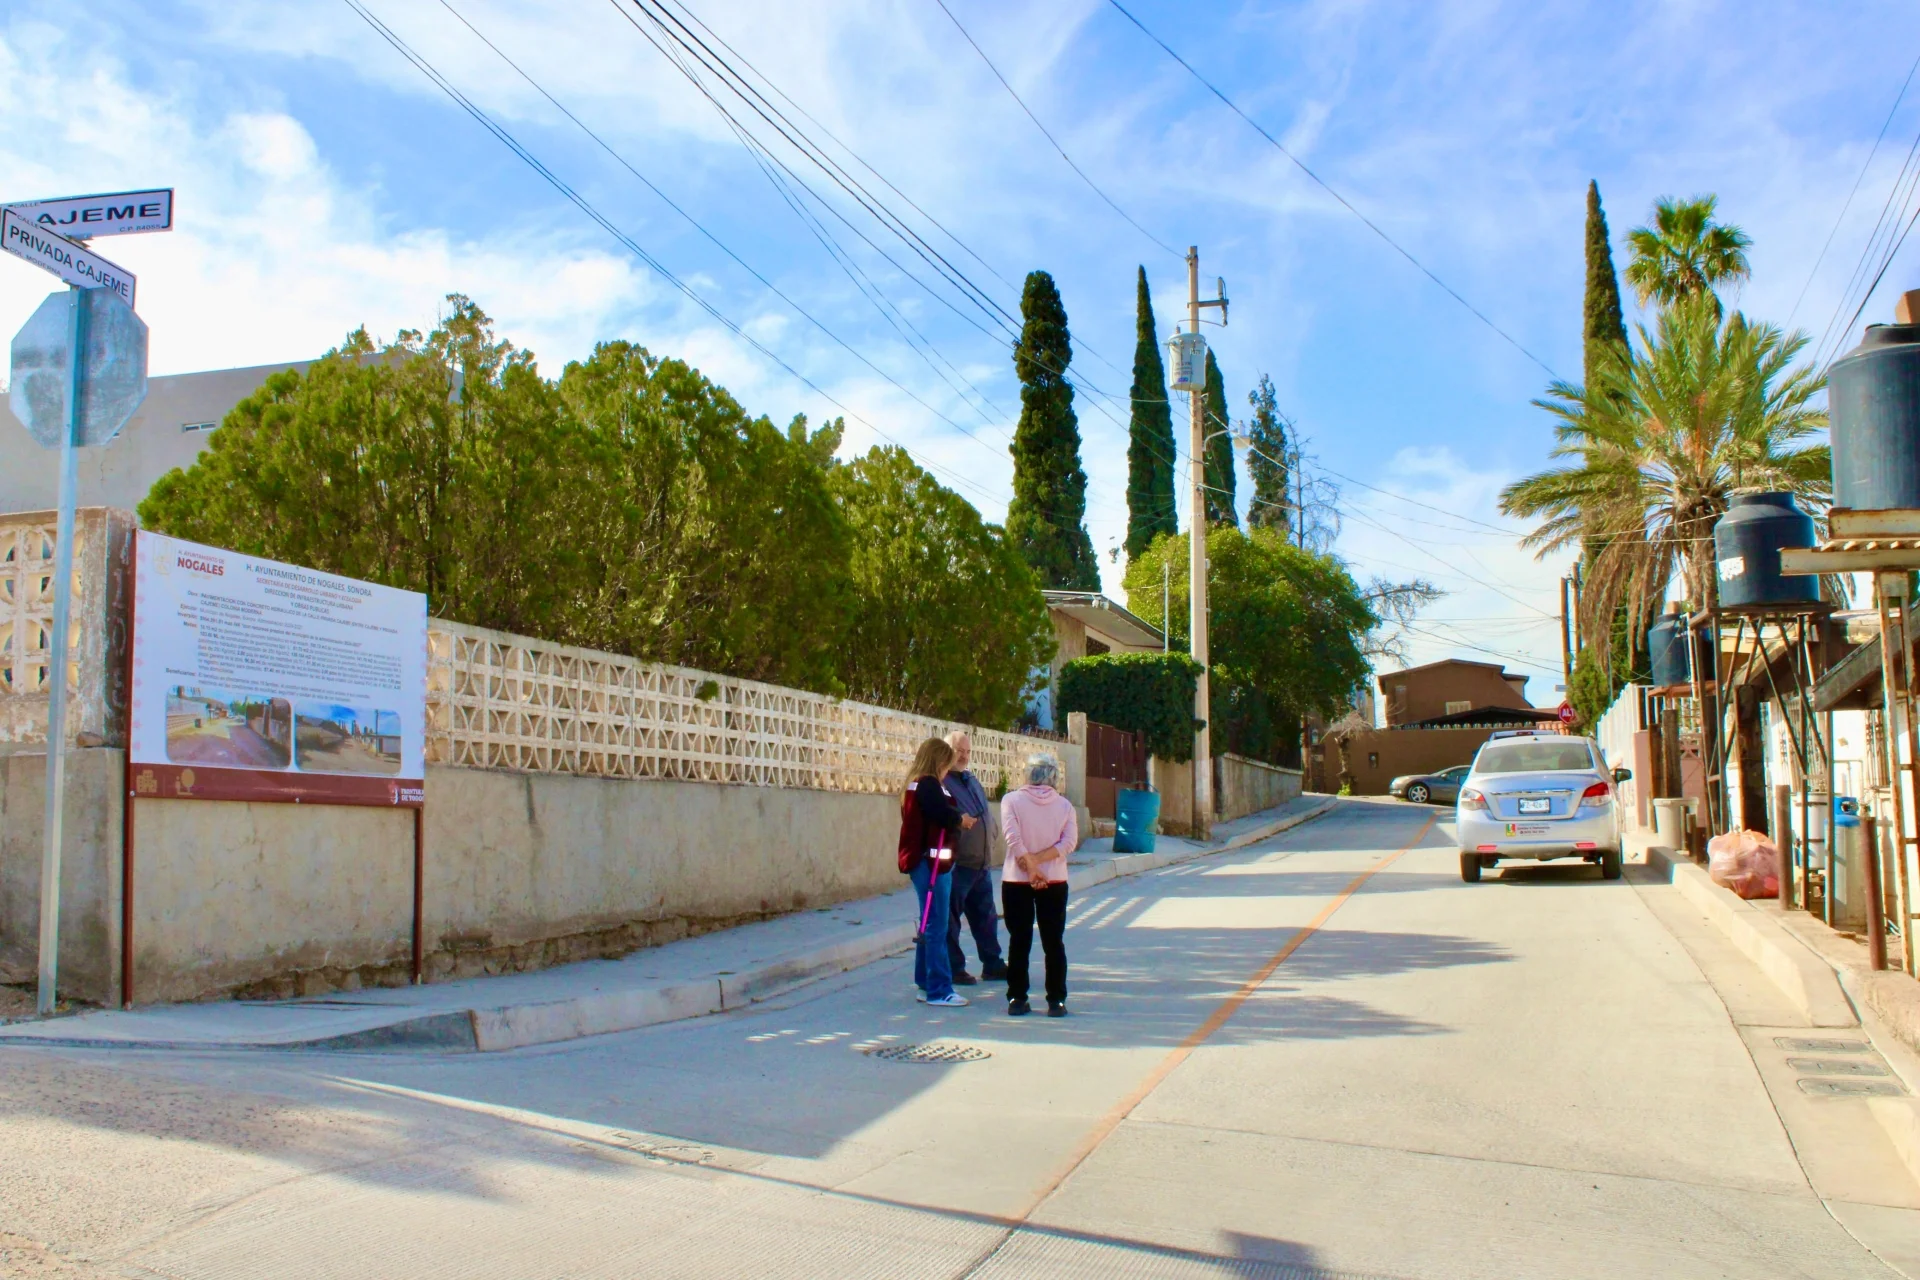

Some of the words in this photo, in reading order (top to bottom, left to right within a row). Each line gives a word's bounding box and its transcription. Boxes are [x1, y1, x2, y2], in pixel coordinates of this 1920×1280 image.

[17, 214, 40, 229] CALLE
[37, 203, 161, 225] AJEME
[10, 225, 73, 268] PRIVADA
[76, 259, 129, 298] CAJEME
[25, 254, 62, 277] MODERNA
[177, 557, 224, 576] NOGALES
[255, 566, 306, 583] AYUNTAMIENTO
[348, 586, 372, 596] SONORA
